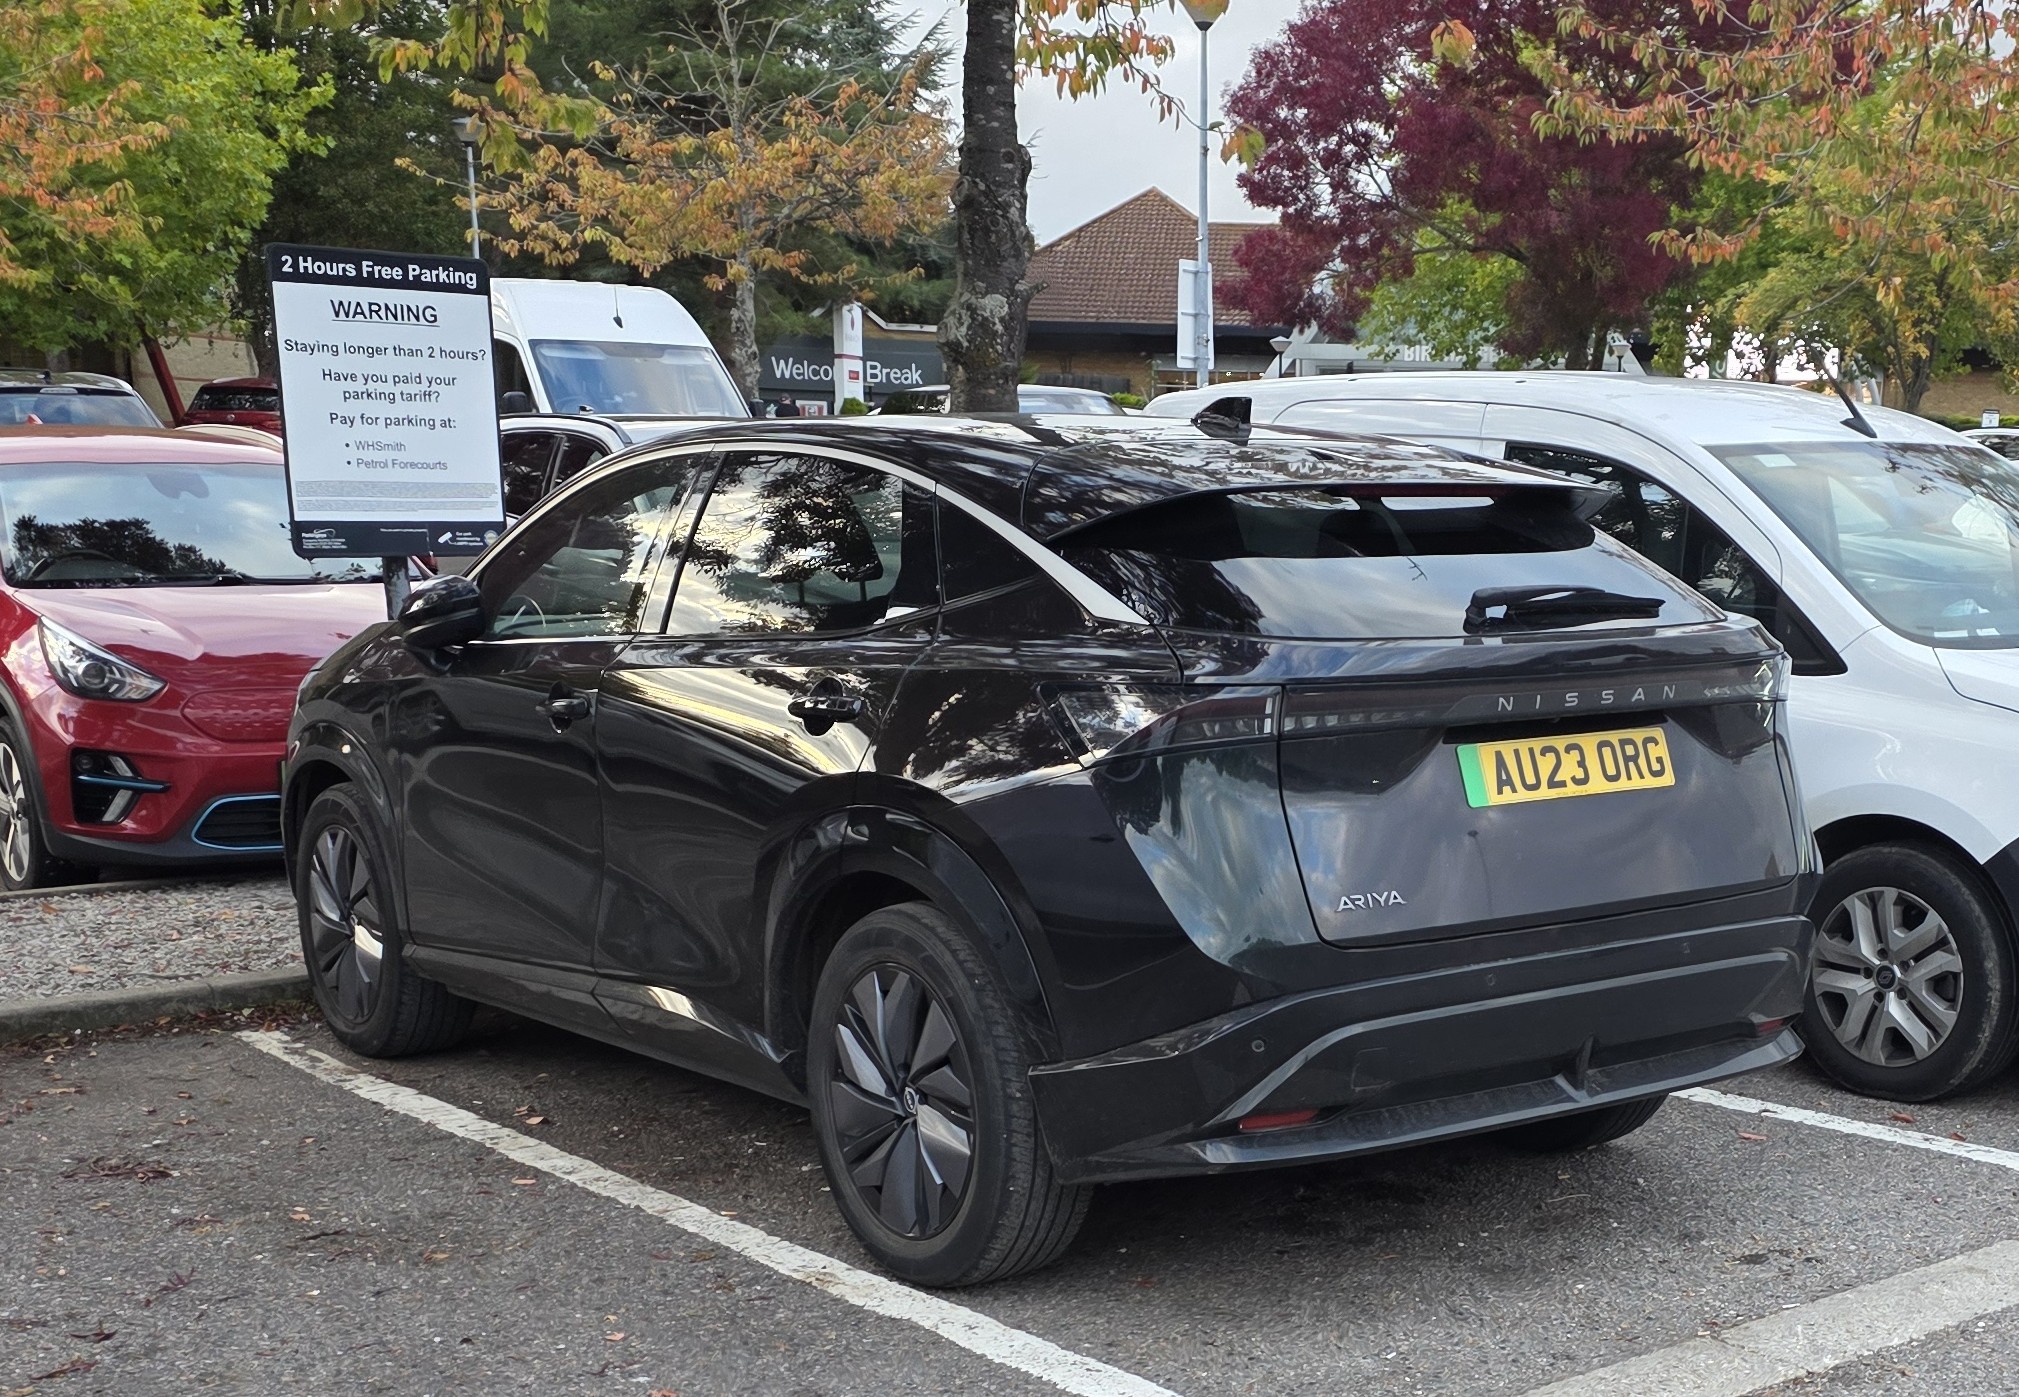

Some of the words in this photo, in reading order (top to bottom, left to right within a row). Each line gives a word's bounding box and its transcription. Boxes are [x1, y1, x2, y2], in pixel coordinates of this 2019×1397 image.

[282, 255, 293, 273] 2
[299, 256, 356, 278] Hours
[362, 260, 402, 280] Free
[408, 264, 477, 289] Parking
[330, 299, 438, 323] WARNING
[284, 338, 339, 357] Staying
[343, 341, 388, 359] longer
[392, 344, 423, 358] than
[427, 346, 436, 359] 2
[439, 346, 486, 361] hours?
[322, 368, 358, 382] Have
[361, 373, 388, 385] you
[392, 373, 422, 386] paid
[425, 375, 457, 388] your
[771, 356, 835, 381] Welco
[866, 361, 923, 385] Break
[343, 388, 396, 403] parking
[400, 390, 440, 403] tariff?
[329, 412, 354, 428] Pay
[360, 413, 379, 426] for
[384, 414, 436, 430] parking
[439, 418, 456, 429] at:
[354, 440, 406, 452] WHSmith
[356, 458, 389, 470] Petrol
[392, 458, 448, 471] Forecourts
[1498, 685, 1676, 711] NISSAN
[1494, 742, 1590, 796] AU23
[1596, 736, 1667, 783] ORG
[1336, 891, 1408, 912] ARIYA
